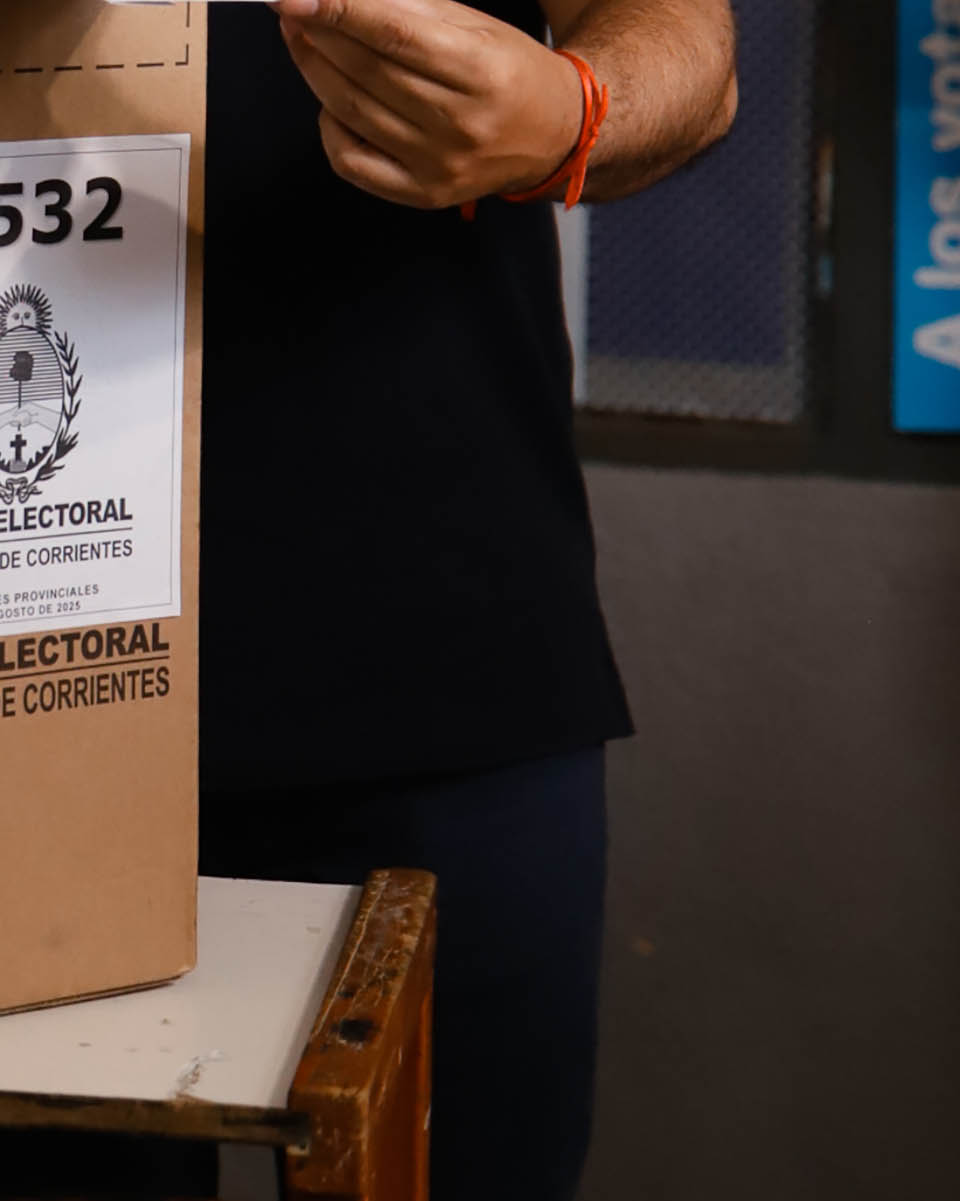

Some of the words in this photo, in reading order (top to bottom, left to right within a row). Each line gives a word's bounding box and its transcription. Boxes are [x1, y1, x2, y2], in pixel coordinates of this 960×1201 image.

[26, 538, 133, 566] CORRIENTES
[14, 583, 100, 603] PROVINCIALES
[39, 602, 53, 615] DE
[56, 600, 81, 614] 2025
[23, 665, 170, 714] CORRIENTES
